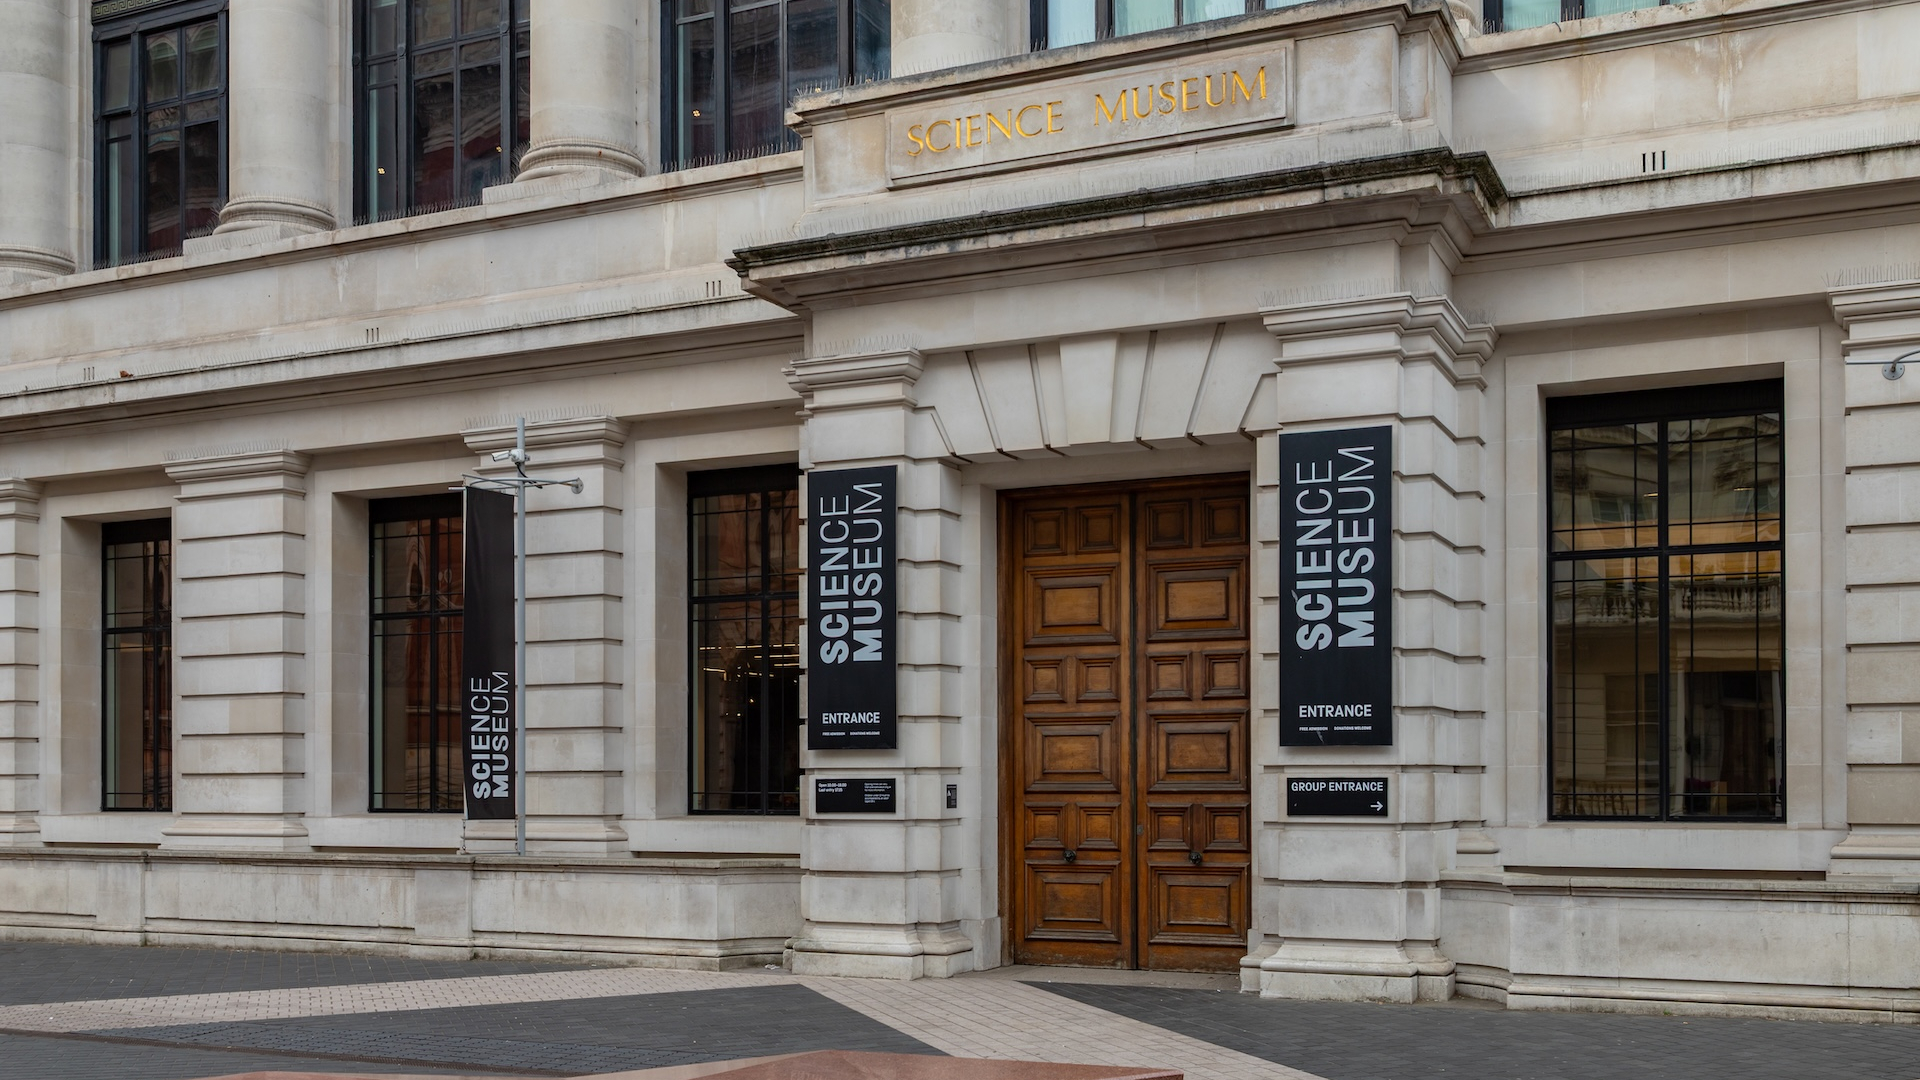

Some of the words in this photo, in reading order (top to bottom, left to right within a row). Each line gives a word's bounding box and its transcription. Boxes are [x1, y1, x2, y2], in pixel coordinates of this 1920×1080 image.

[907, 101, 1062, 157] SCIENCE
[1095, 66, 1267, 126] MUSEUM
[820, 495, 850, 664] SCIENCE
[852, 483, 883, 662] MUSEUM
[1296, 460, 1333, 650] SCIENCE
[1337, 446, 1375, 648] MUSEUM
[470, 677, 491, 799] SCIENCE
[492, 671, 509, 798] MUSEUM
[822, 712, 880, 724] ENTRANCE
[1298, 704, 1372, 718] ENTRANCE
[1291, 781, 1327, 792] GROUP
[1328, 781, 1384, 792] ENTRANCE
